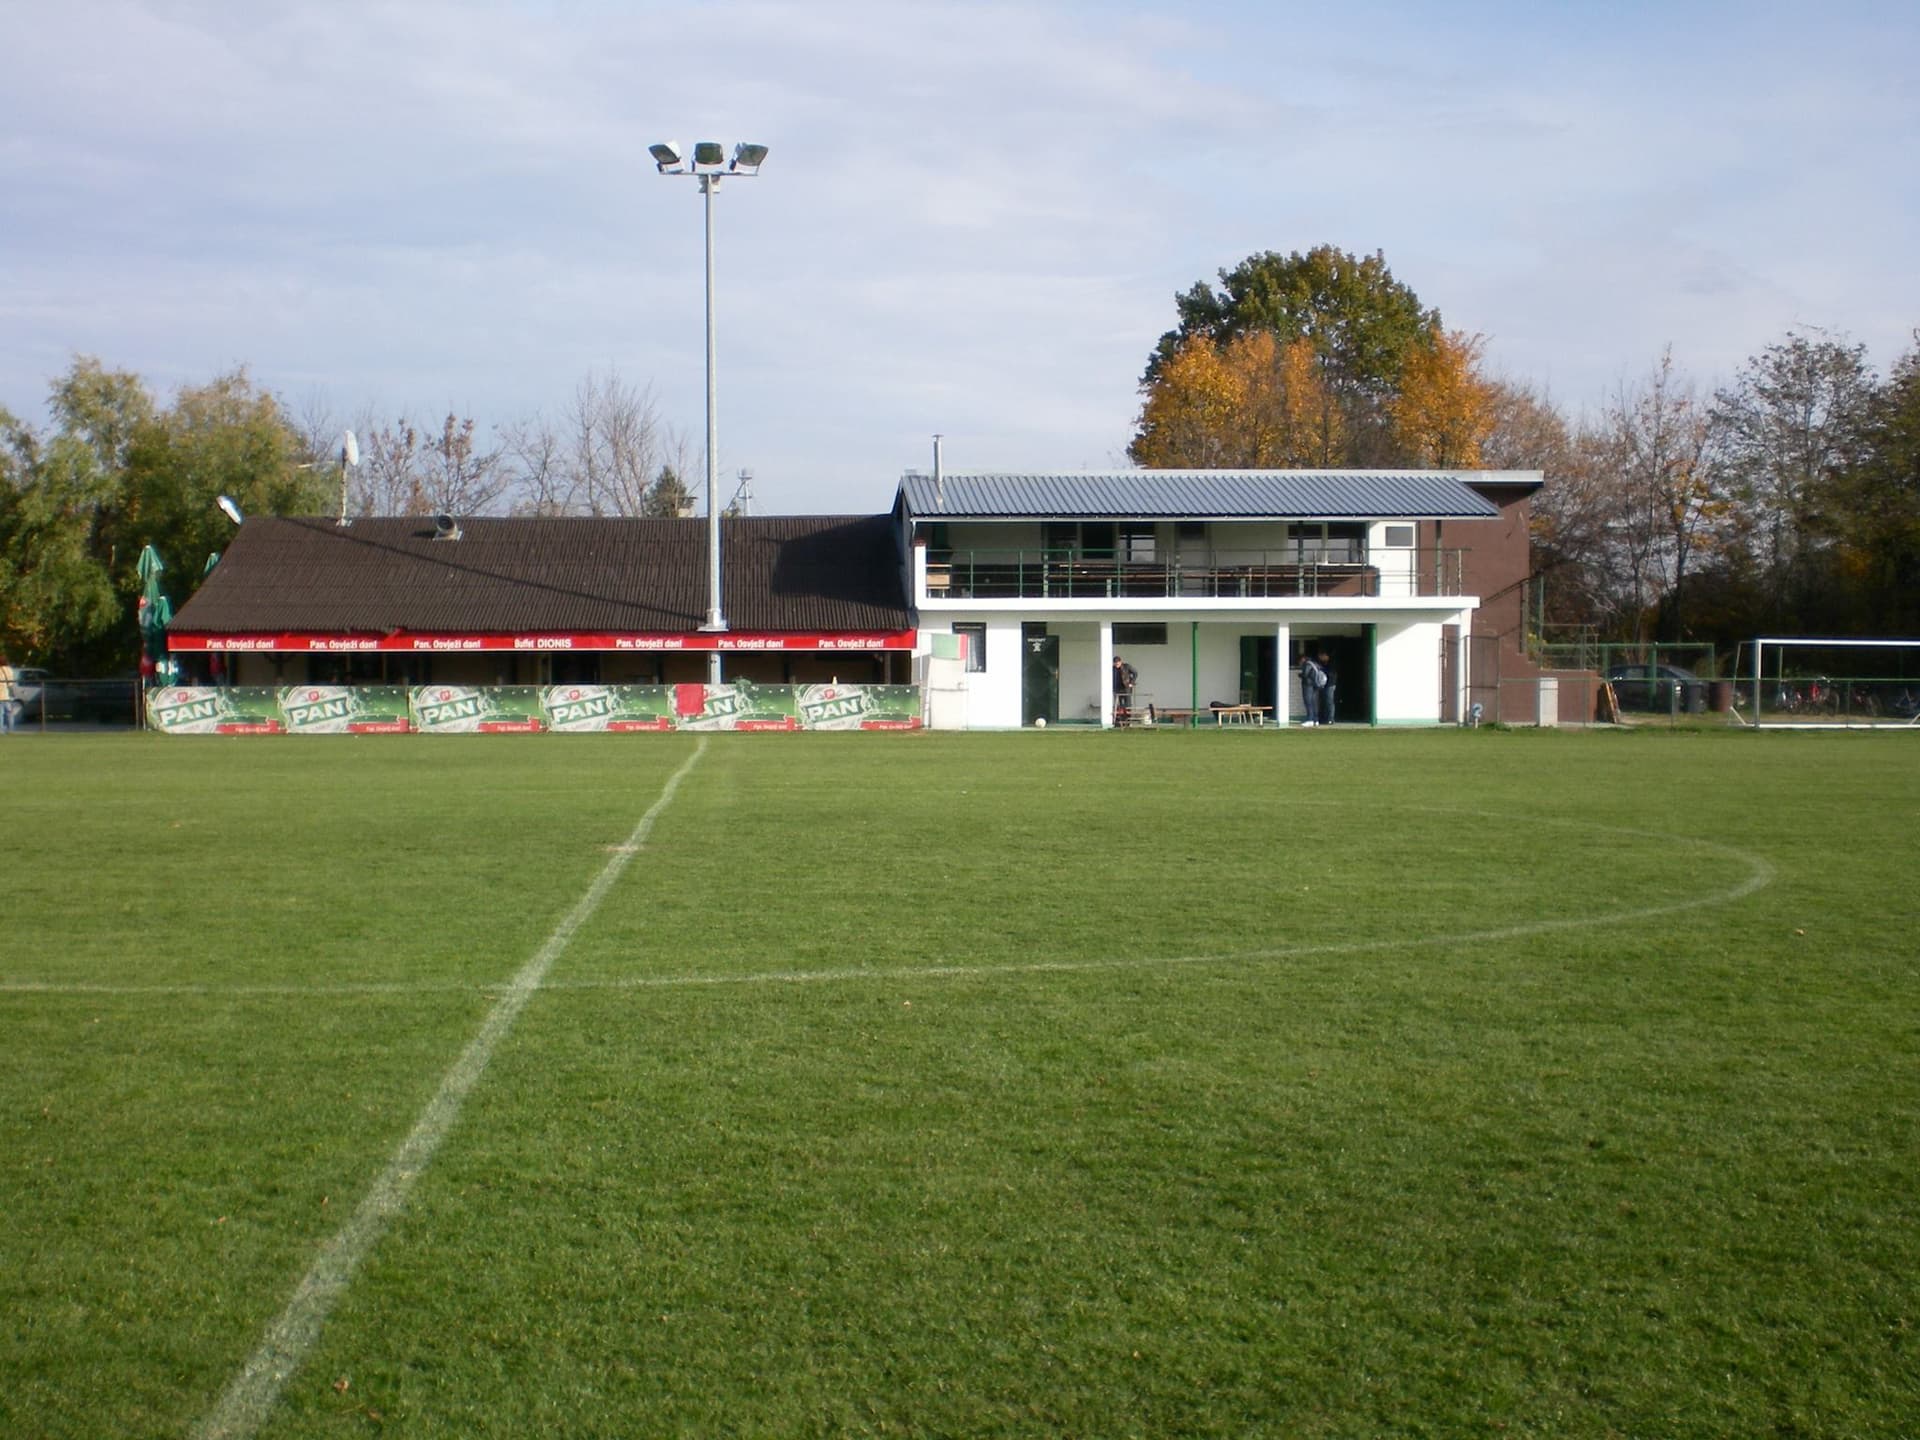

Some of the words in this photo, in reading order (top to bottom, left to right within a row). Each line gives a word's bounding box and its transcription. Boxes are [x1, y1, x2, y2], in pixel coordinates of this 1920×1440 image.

[537, 638, 572, 648] DIONIS
[160, 700, 213, 725] PAN
[291, 700, 346, 724] PAN
[422, 700, 475, 724] PAN
[552, 699, 605, 723] PAN
[807, 698, 860, 722] PAN
